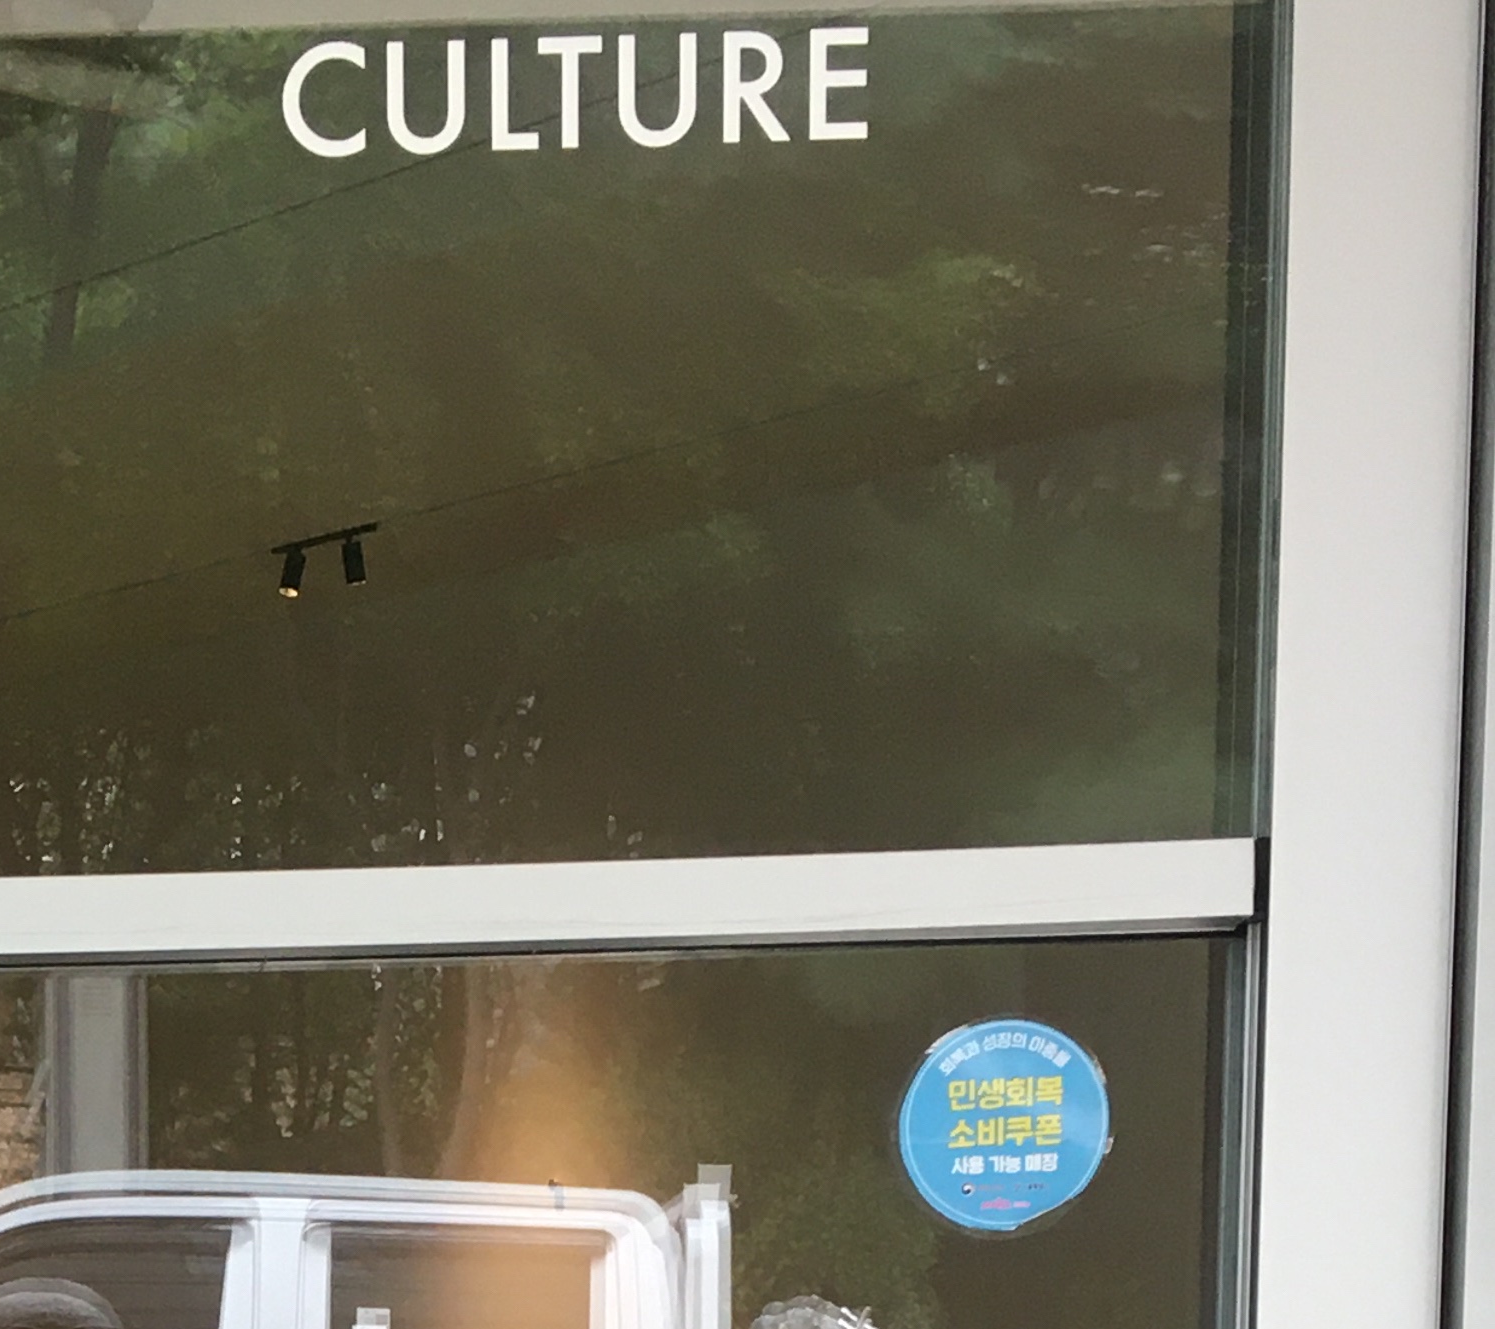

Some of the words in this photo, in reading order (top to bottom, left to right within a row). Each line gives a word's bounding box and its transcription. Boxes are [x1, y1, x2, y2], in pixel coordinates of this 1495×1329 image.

[282, 26, 868, 157] CULTURE
[982, 1032, 1028, 1051] 성장의
[947, 1076, 1064, 1111] 민생회복
[947, 1114, 1063, 1148] 소비쿠폰
[951, 1155, 985, 1175] 사용
[989, 1155, 1021, 1173] 가능
[1025, 1152, 1058, 1172] 매장
